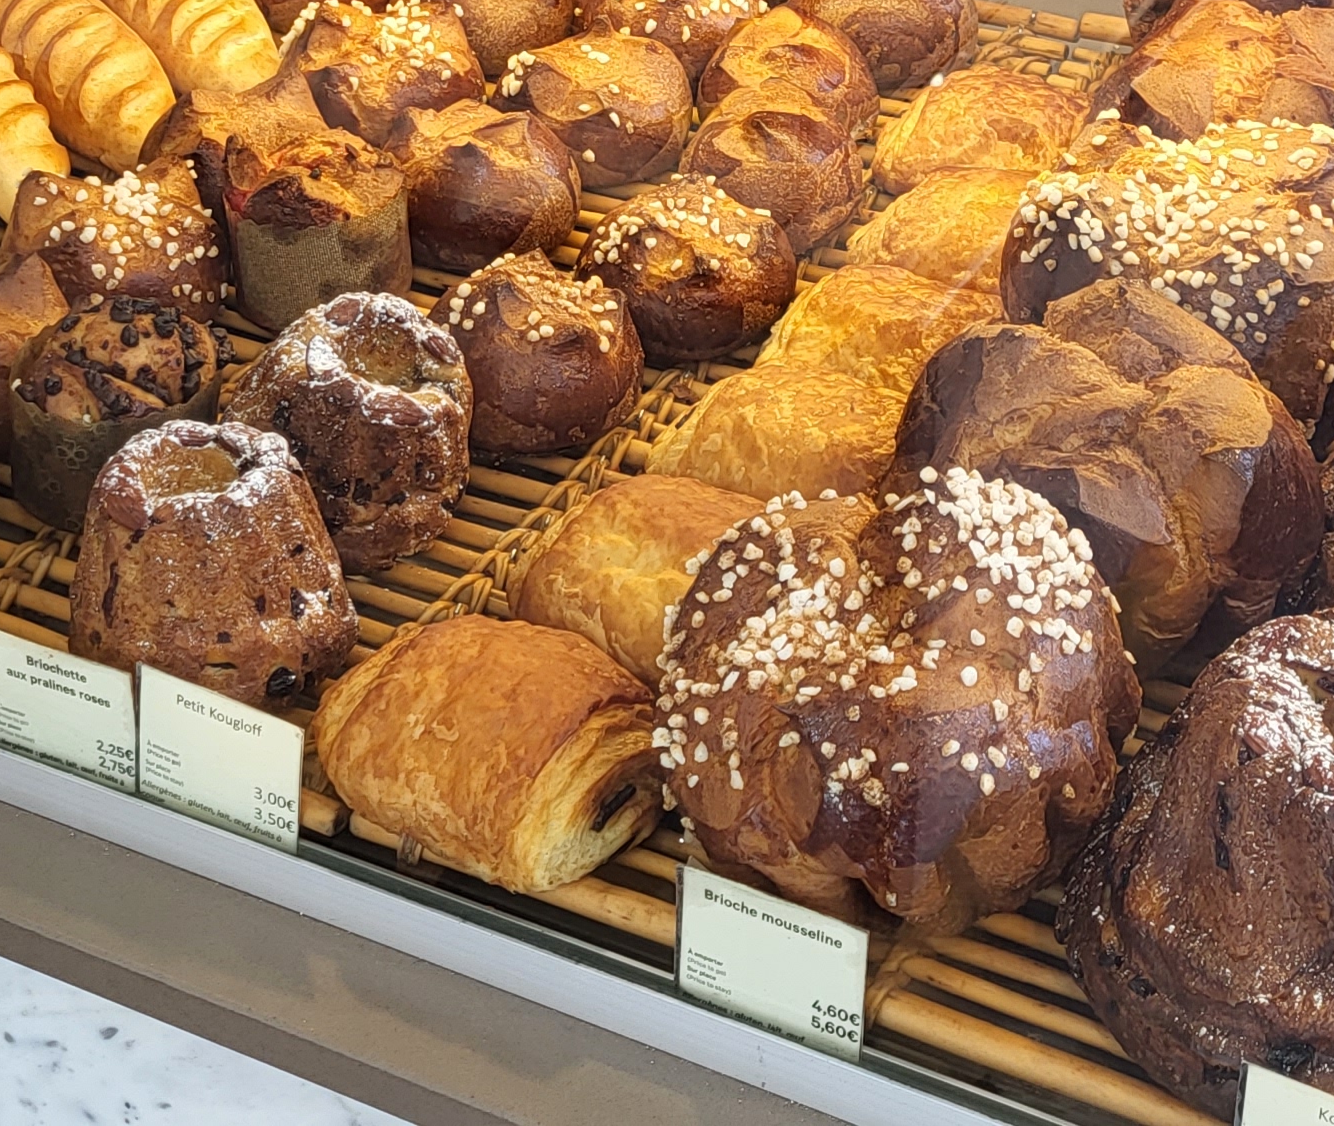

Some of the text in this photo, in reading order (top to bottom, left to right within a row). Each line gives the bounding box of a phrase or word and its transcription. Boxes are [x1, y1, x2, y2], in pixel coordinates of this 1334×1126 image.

[27, 655, 87, 683] Briochette
[7, 668, 110, 708] aux pralines roses
[176, 694, 263, 737] Petit Kougloff
[96, 740, 134, 761] 2,25€
[98, 756, 135, 777] 2,75€
[141, 779, 181, 802] Allergènes
[188, 799, 215, 815] gluten,
[252, 823, 275, 839] fruits
[253, 787, 296, 812] 3,00€
[254, 807, 295, 834] 3,50€
[704, 888, 843, 949] Brioche mousseline
[811, 1000, 860, 1026] 4,60€
[811, 1015, 858, 1043] 5,60€
